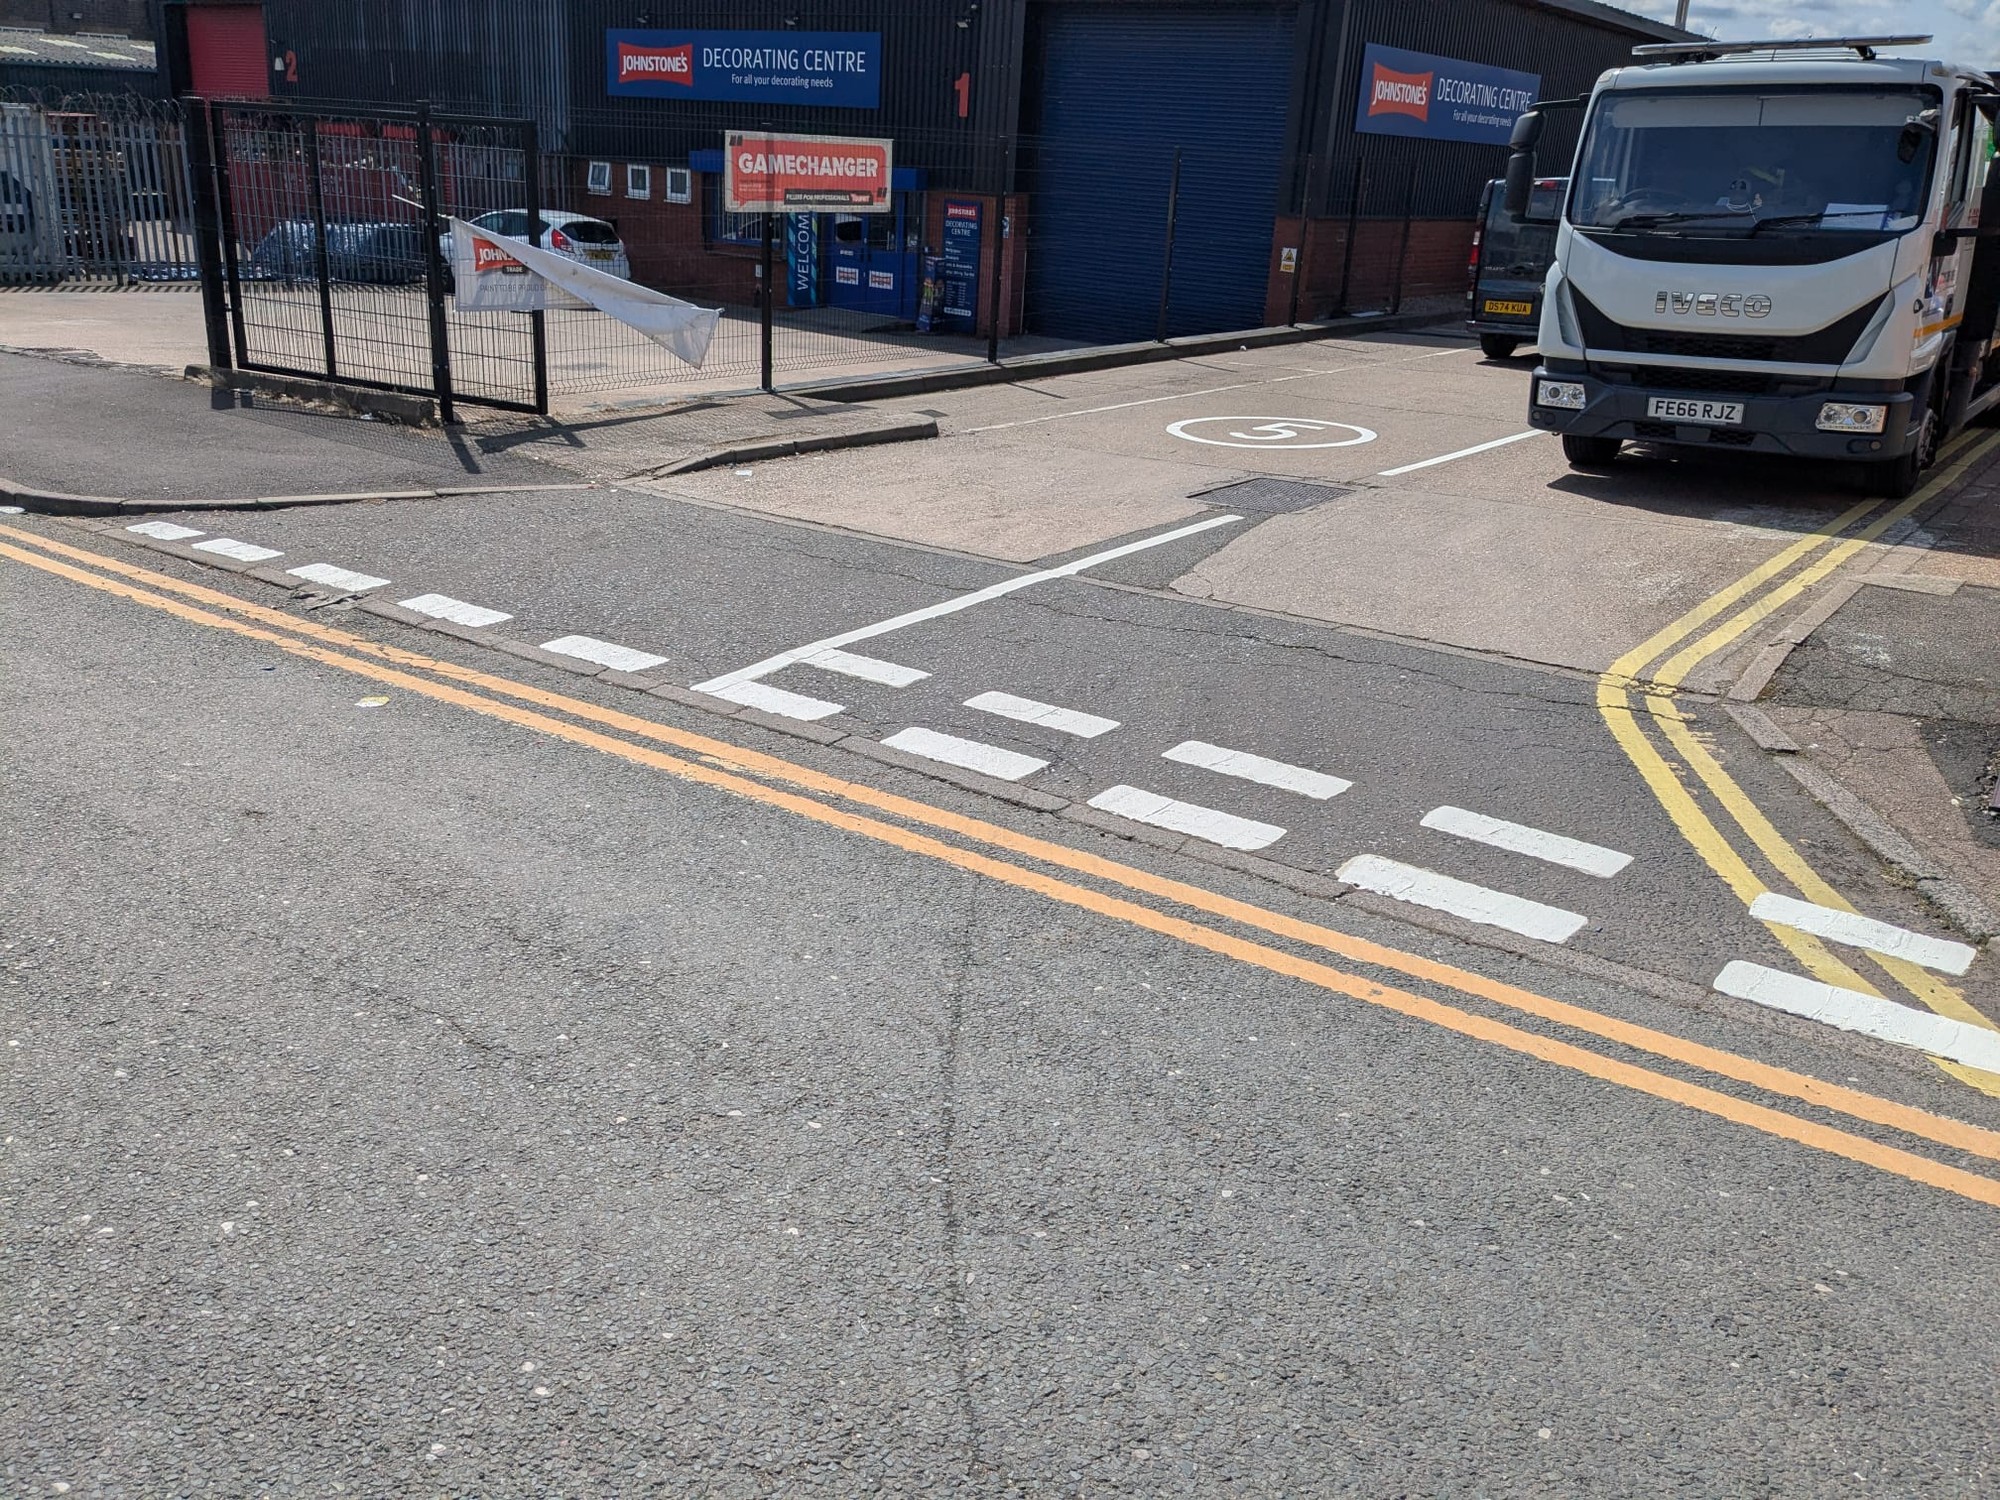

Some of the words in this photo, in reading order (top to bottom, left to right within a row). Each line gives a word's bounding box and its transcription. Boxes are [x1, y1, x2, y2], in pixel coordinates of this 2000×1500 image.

[285, 50, 298, 82] 2
[622, 52, 688, 75] JOHNSTONE'S
[703, 48, 799, 70] DECORATING
[803, 50, 866, 73] CENTRE
[731, 73, 743, 84] For
[743, 74, 753, 85] all
[753, 76, 770, 87] your
[771, 75, 810, 89] decorating
[810, 77, 833, 88] needs
[1372, 80, 1427, 106] JOHNSTONE'S
[954, 72, 970, 117] 1
[1437, 77, 1498, 109] DECORATING
[1499, 88, 1533, 112] CENTRE
[1452, 109, 1460, 121] For
[738, 152, 878, 178] GAMECHANGER
[950, 228, 971, 236] CENTRE
[797, 213, 810, 291] WELCOM
[1488, 302, 1510, 311] DS74
[1511, 304, 1528, 313] KUA
[1655, 291, 1772, 318] IVECO
[1654, 400, 1698, 417] FE66
[1702, 403, 1737, 420] RJZ
[1229, 422, 1325, 440] 5
